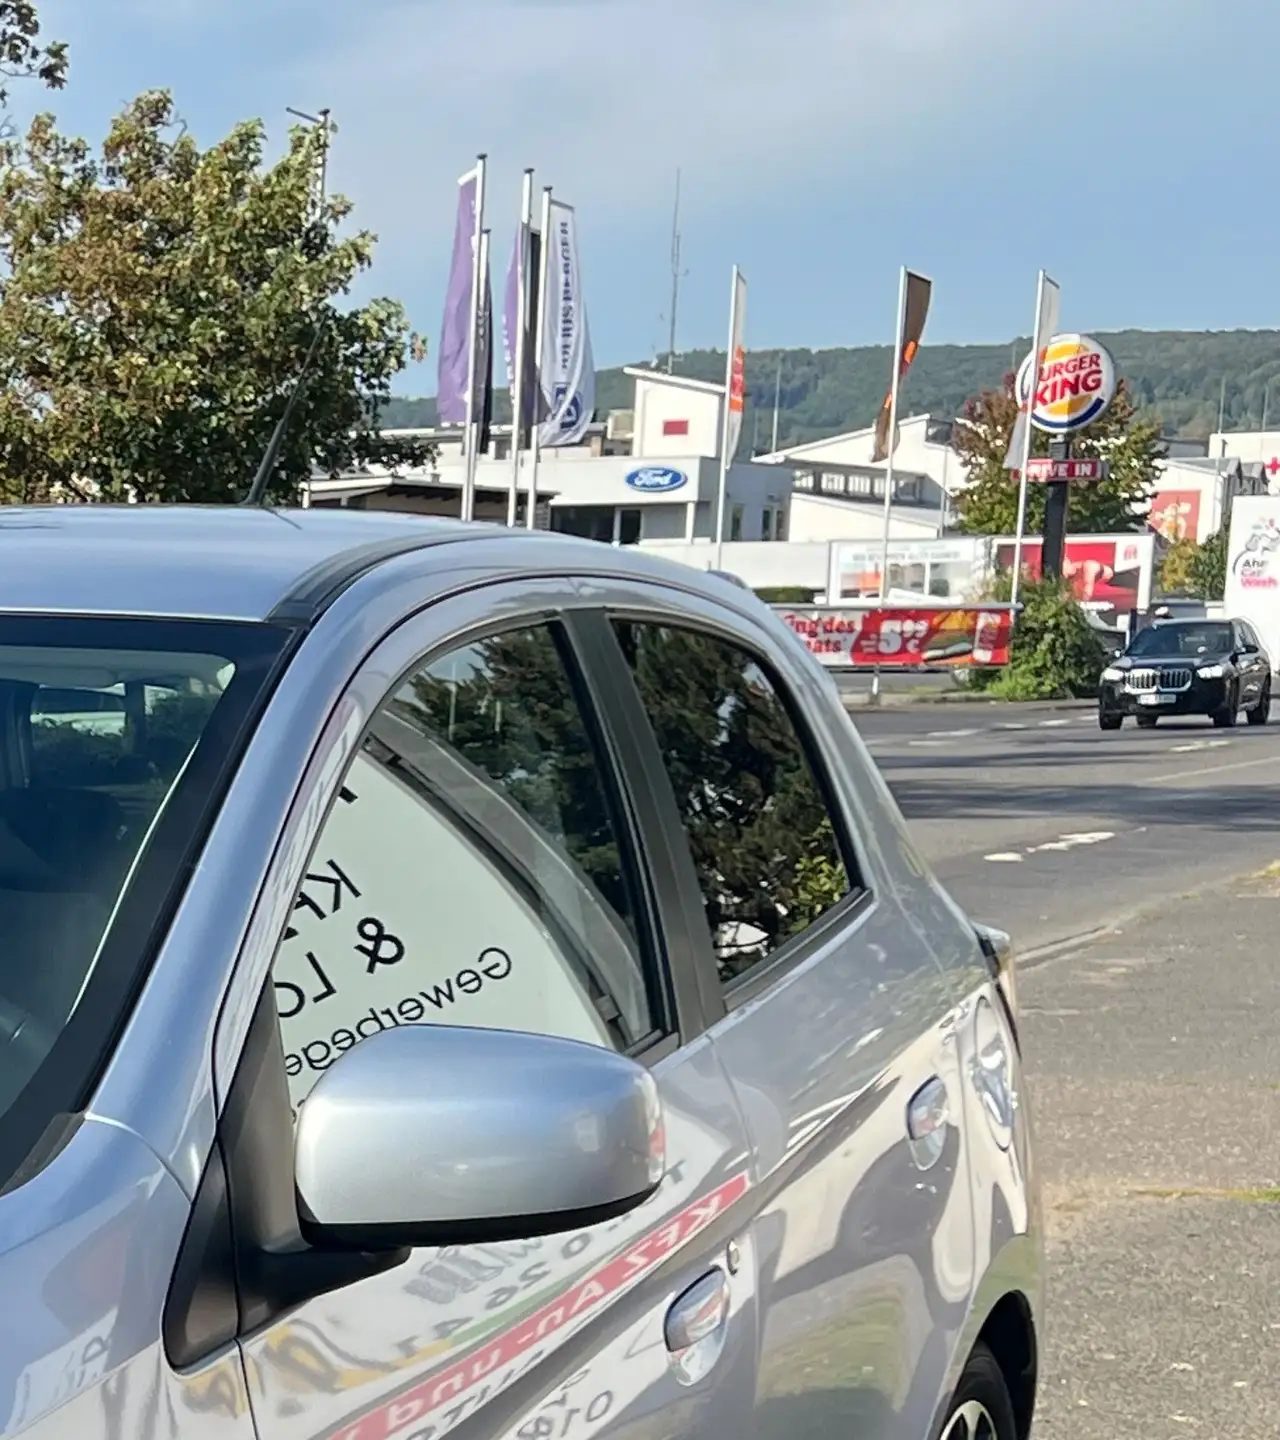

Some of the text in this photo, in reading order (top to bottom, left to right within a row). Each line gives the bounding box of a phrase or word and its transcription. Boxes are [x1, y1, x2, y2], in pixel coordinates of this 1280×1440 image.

[1038, 352, 1101, 382] URGER
[1035, 369, 1103, 406] KING
[634, 468, 673, 486] Ford
[1075, 463, 1092, 477] IN
[823, 616, 855, 633] des
